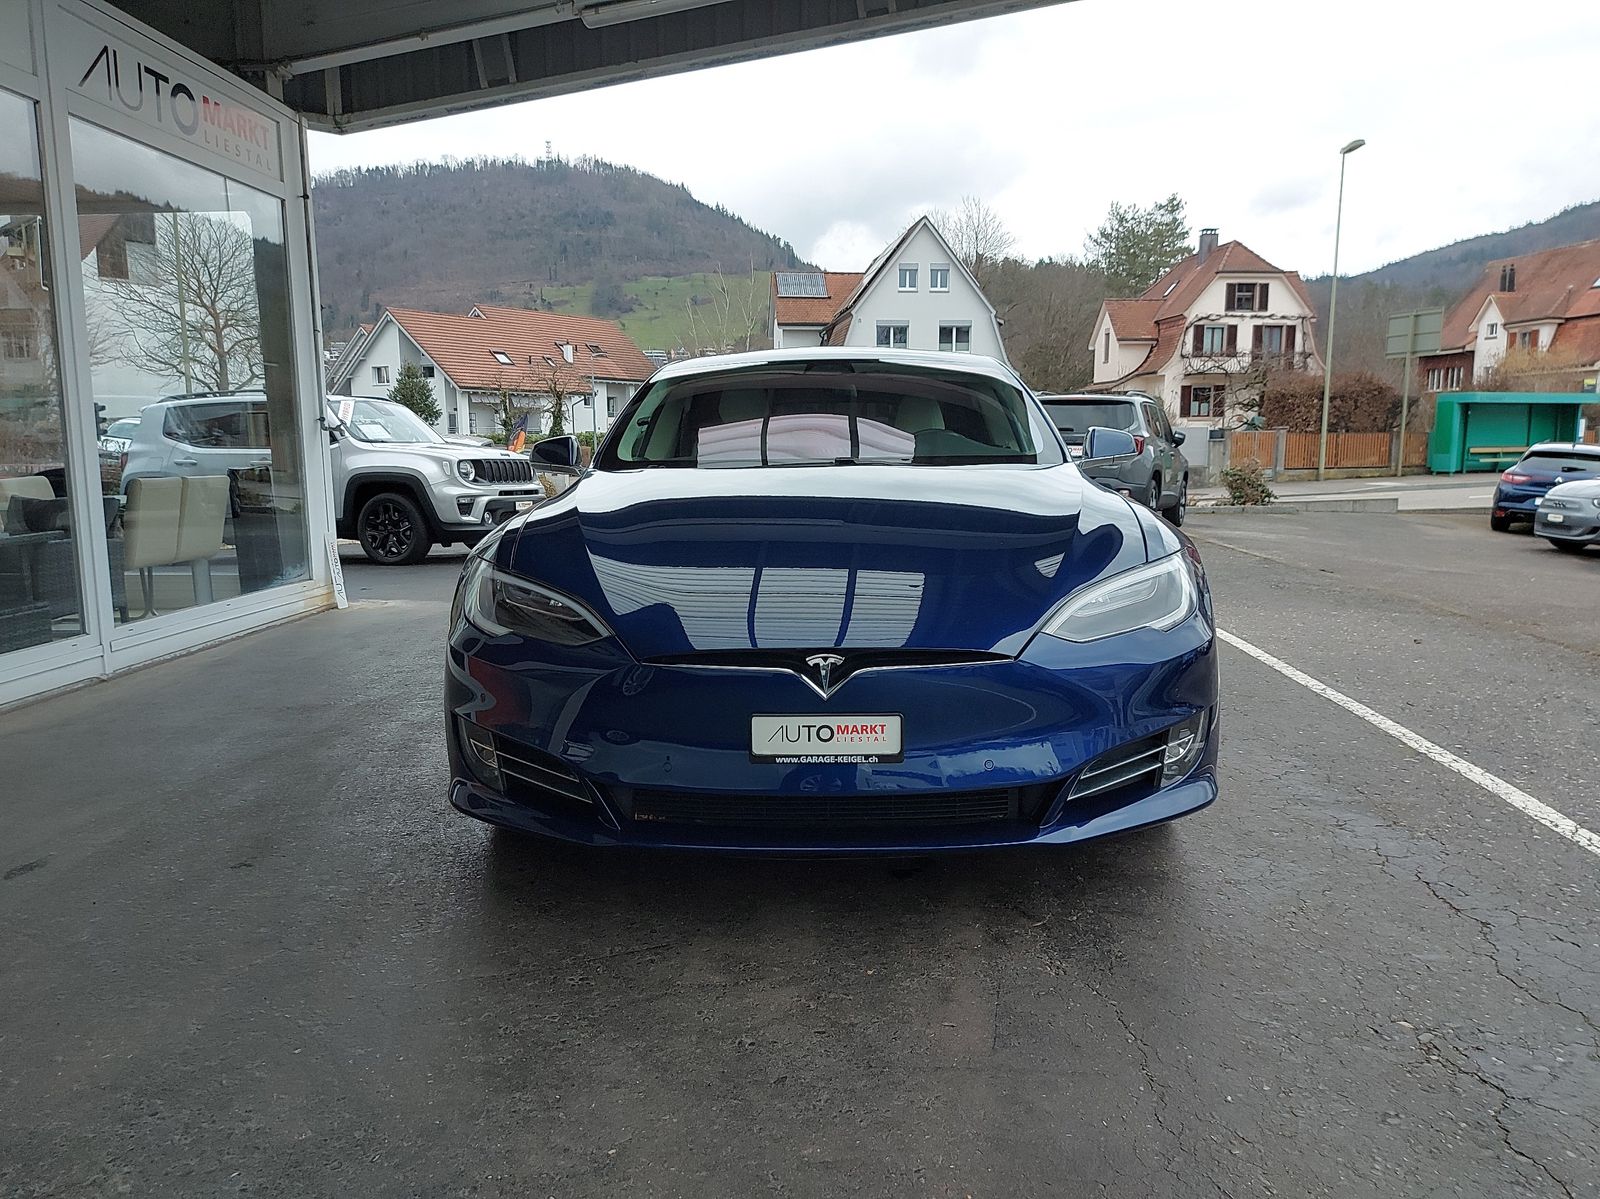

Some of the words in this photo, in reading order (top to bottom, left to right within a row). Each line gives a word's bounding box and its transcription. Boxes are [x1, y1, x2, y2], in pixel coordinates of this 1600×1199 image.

[78, 45, 199, 136] AUTO
[202, 95, 270, 151] MARKT
[203, 129, 272, 171] LIESTAL
[767, 724, 835, 743] AUTO
[836, 724, 887, 735] MARKT
[775, 755, 879, 764] www.GARAGE-KEIGEL.ch
